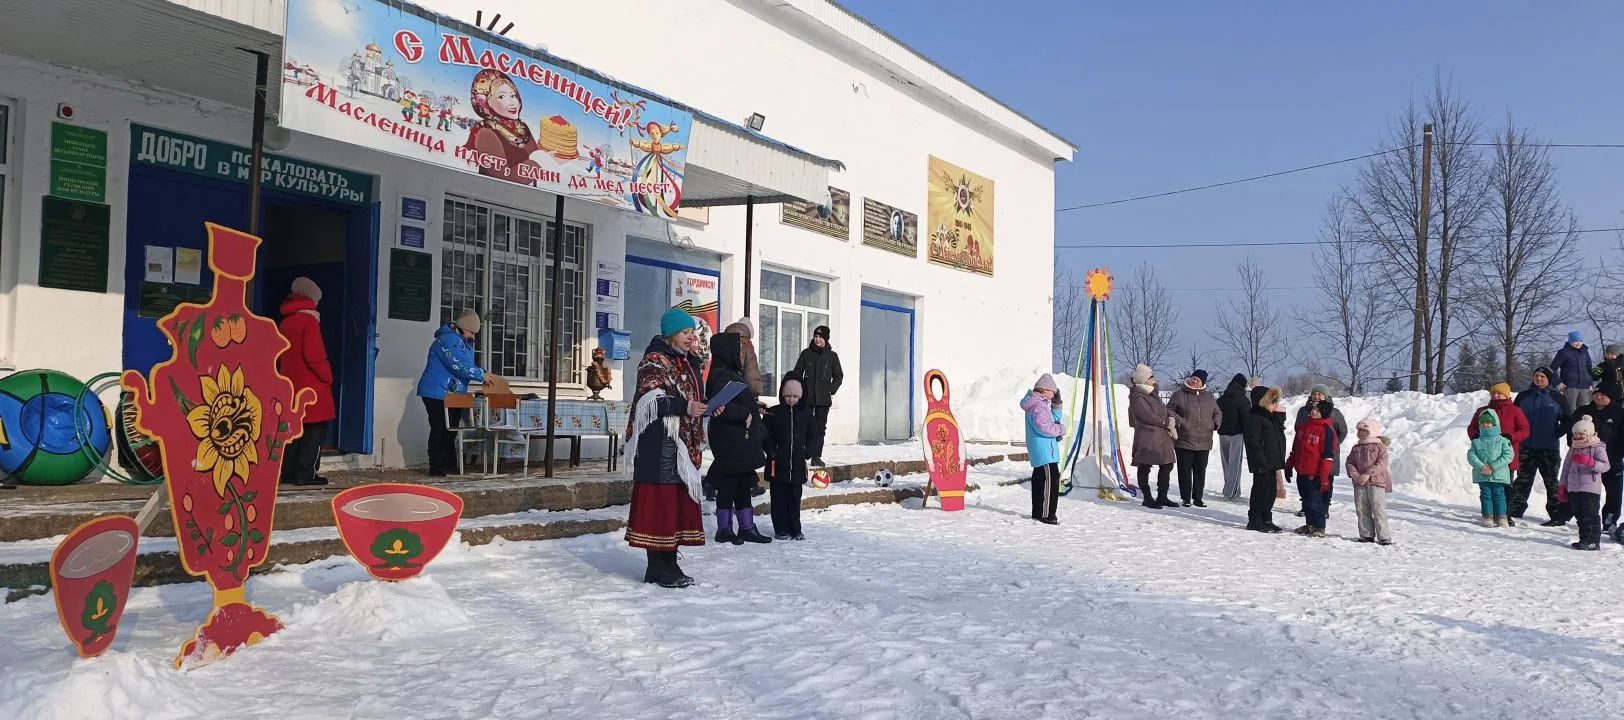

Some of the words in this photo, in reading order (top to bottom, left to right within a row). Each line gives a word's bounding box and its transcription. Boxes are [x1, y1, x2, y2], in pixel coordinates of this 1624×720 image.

[394, 30, 424, 62] С
[440, 34, 632, 131] Масленицей!
[138, 131, 208, 171] ДОБРО
[305, 82, 445, 152] Масленица
[568, 176, 588, 189] да
[594, 178, 624, 195] мед
[217, 160, 230, 175] В
[237, 166, 272, 183] МР
[275, 174, 364, 202] КУЛЬТУРЫ
[687, 277, 716, 290] ГОРДИМСЯ!
